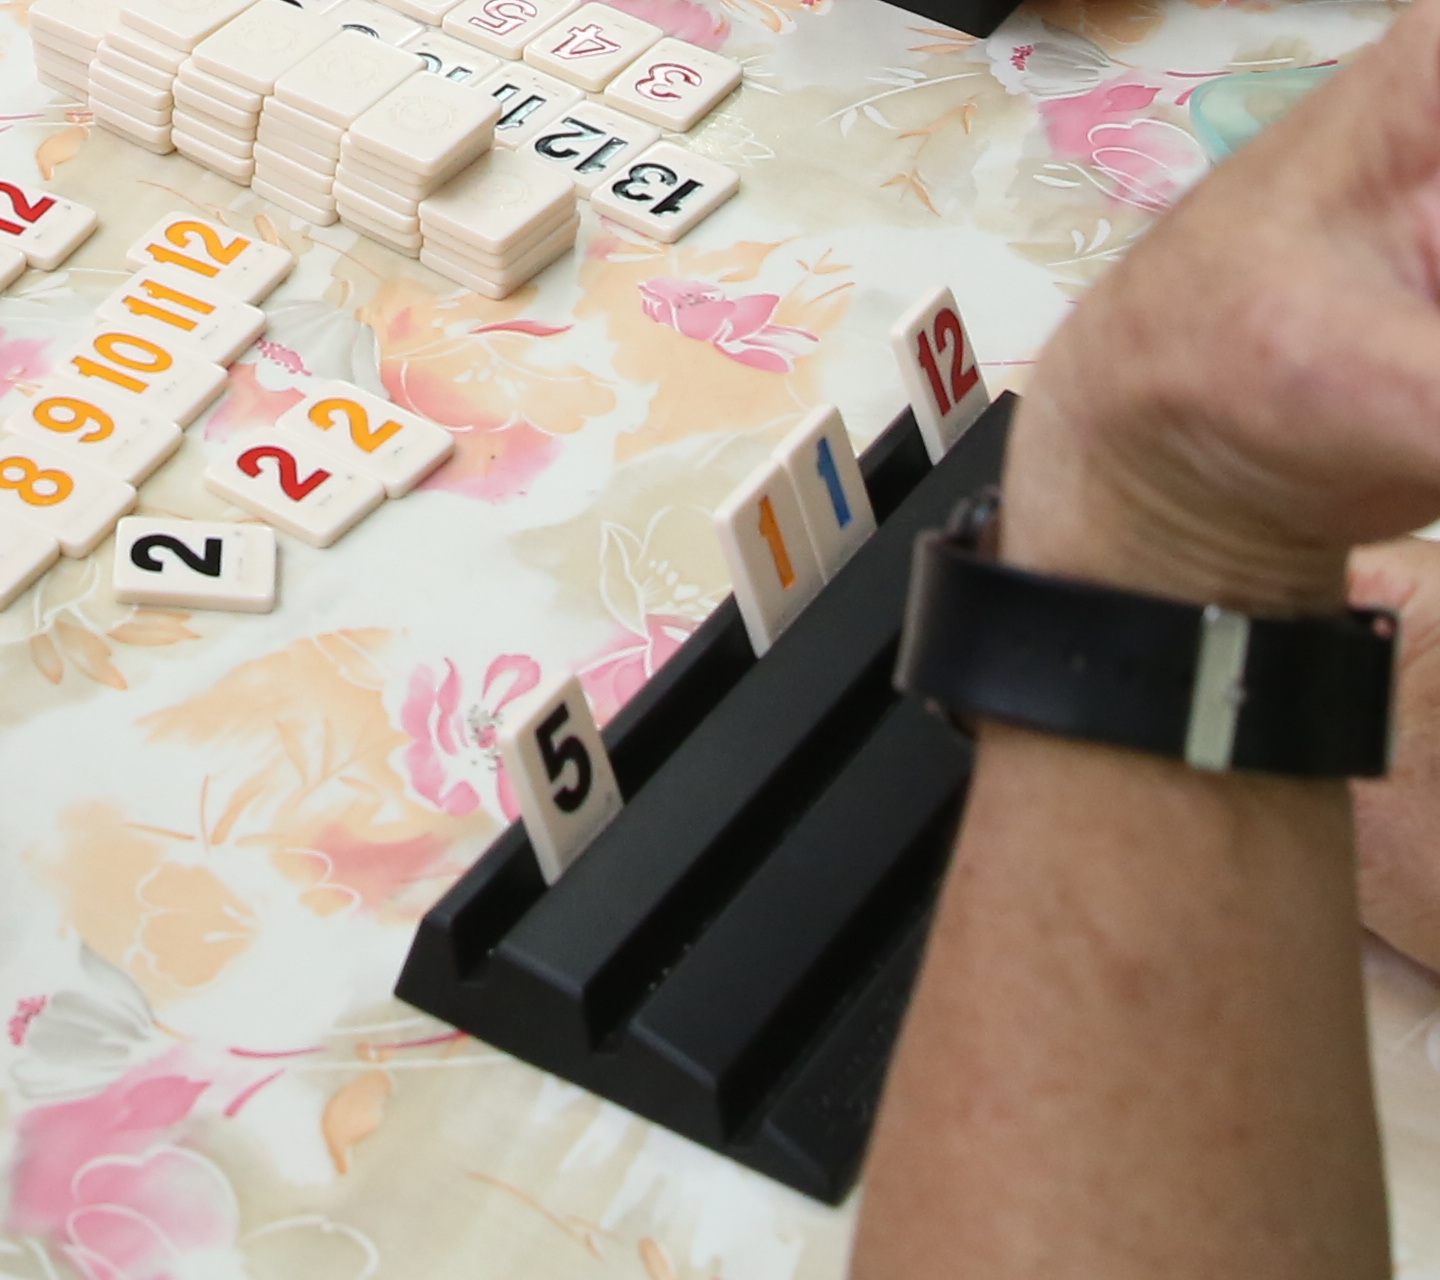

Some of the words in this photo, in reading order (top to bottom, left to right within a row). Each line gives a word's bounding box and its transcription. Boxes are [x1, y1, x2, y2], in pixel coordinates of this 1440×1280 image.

[552, 23, 621, 60] 4
[635, 63, 703, 102] 3
[534, 117, 628, 175] 12
[611, 163, 704, 215] 13
[148, 222, 249, 277] 12
[125, 281, 214, 330] 11
[74, 334, 172, 393] 10
[917, 307, 978, 416] 12
[34, 398, 114, 442] 9
[238, 446, 330, 501] 2
[310, 399, 402, 453] 2
[758, 495, 795, 590] 1
[817, 436, 852, 528] 1
[131, 535, 222, 577] 2
[535, 703, 593, 815] 5
